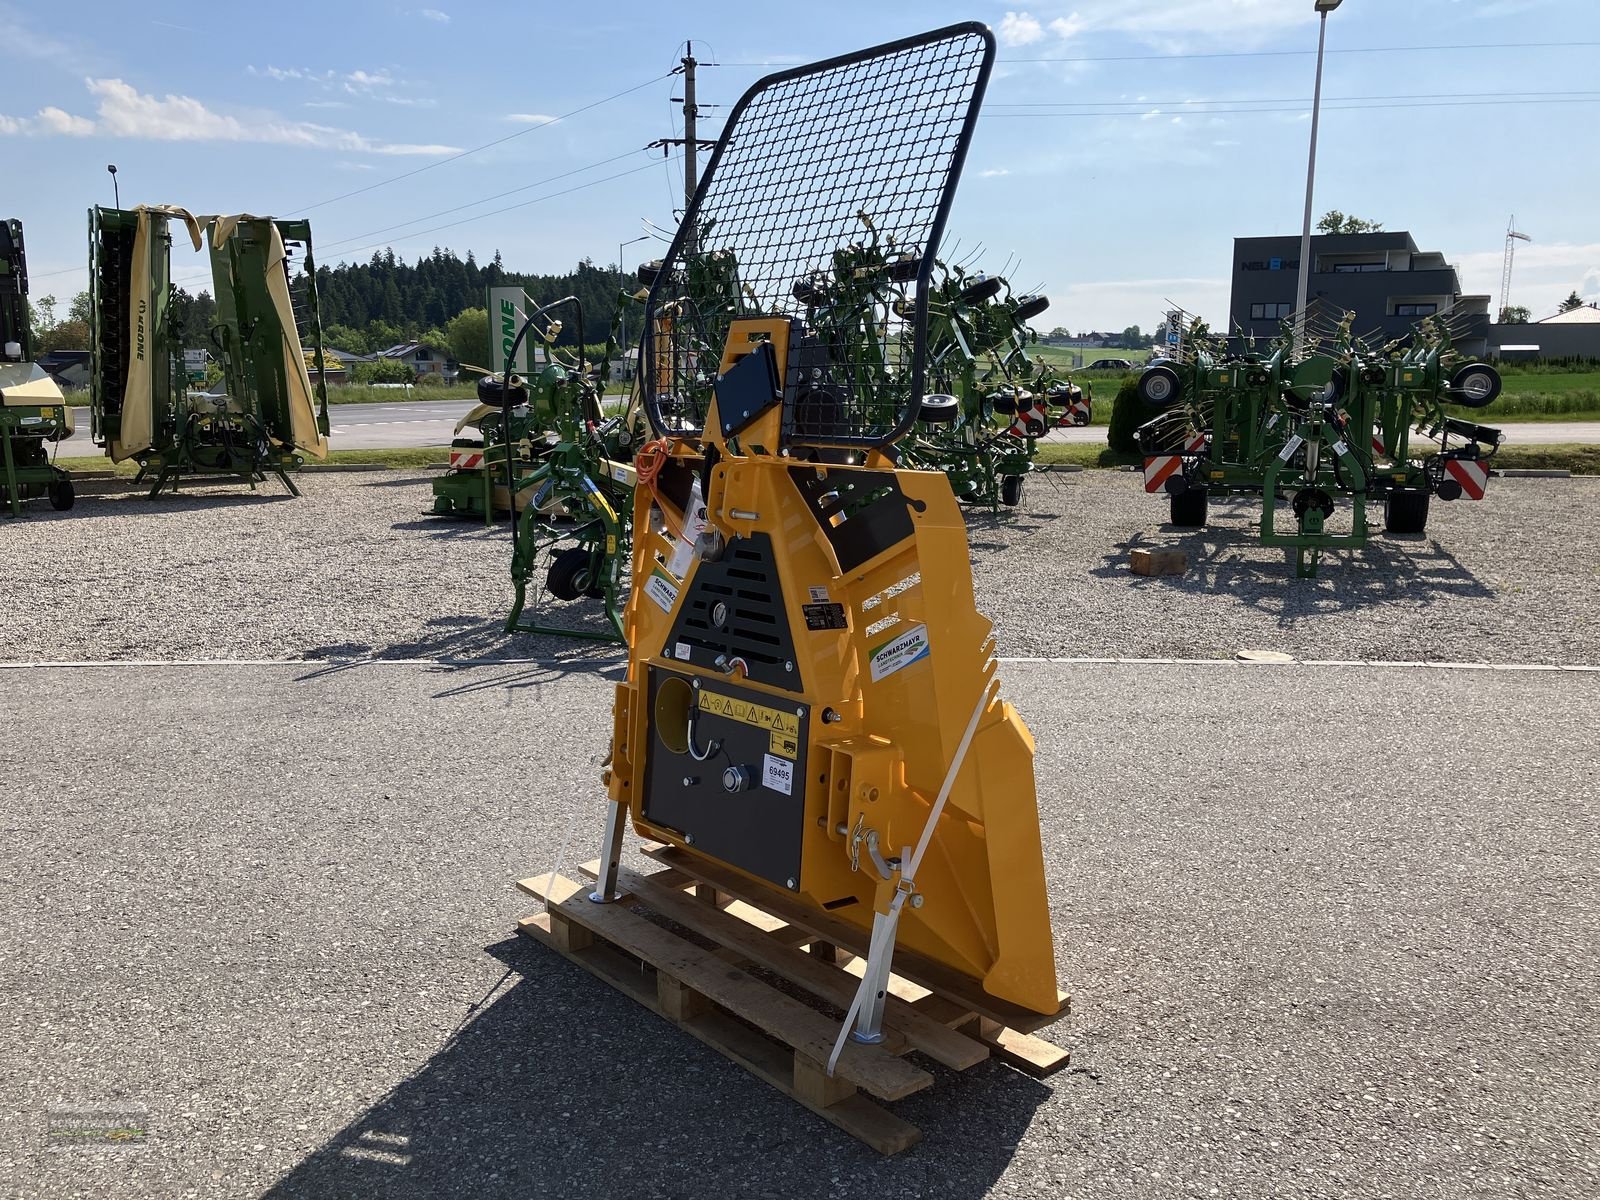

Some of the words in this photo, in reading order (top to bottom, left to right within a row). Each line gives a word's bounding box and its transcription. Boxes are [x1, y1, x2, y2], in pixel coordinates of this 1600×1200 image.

[136, 316, 144, 361] KRONE
[655, 577, 676, 601] SCHWARZ
[876, 635, 920, 663] SCHWARZMAYR
[769, 765, 790, 781] 69495
